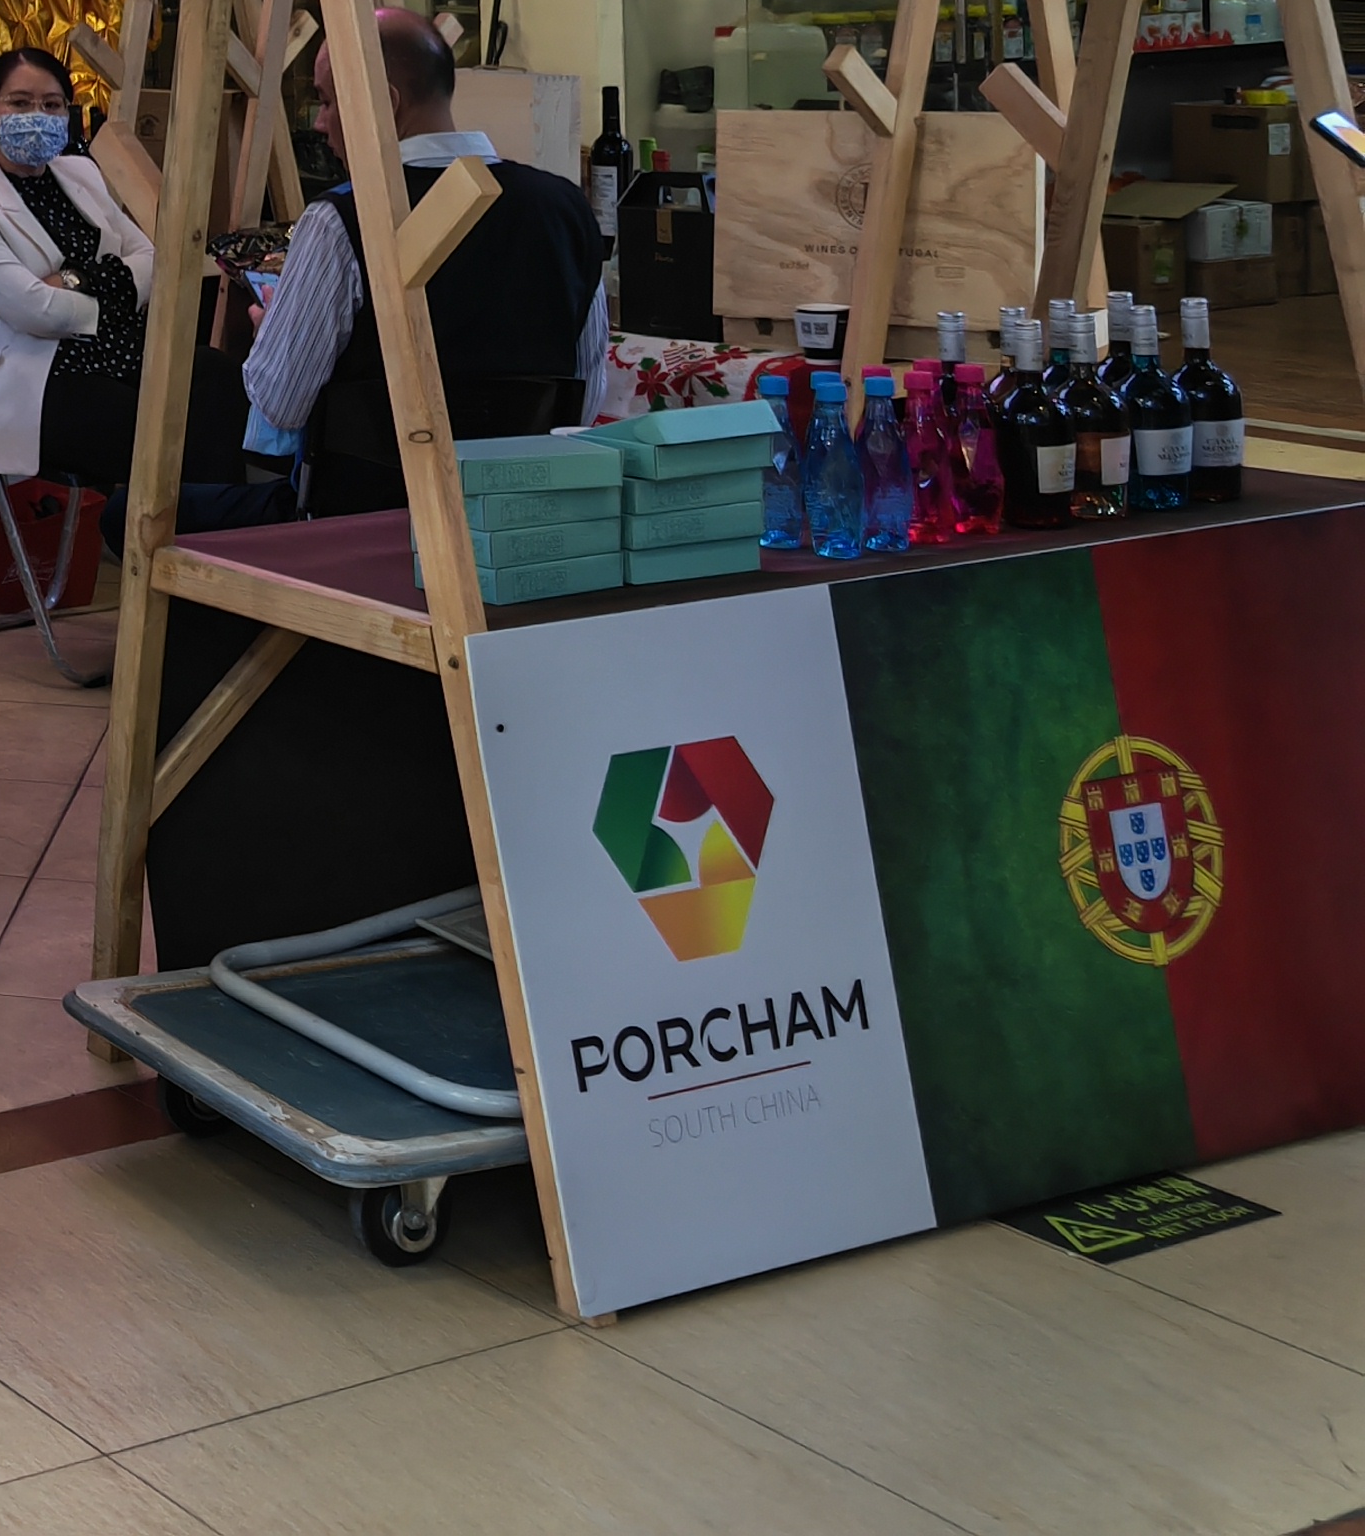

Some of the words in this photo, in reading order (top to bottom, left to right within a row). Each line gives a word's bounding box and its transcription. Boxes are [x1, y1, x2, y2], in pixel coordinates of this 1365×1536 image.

[805, 244, 846, 255] WINES
[570, 978, 870, 1094] PORCHAM
[648, 1101, 737, 1149] SOUTH
[744, 1084, 822, 1127] CHINA
[1136, 1199, 1221, 1227] CAUTION
[1145, 1221, 1193, 1239] WET
[1186, 1205, 1256, 1229] FLOOR
